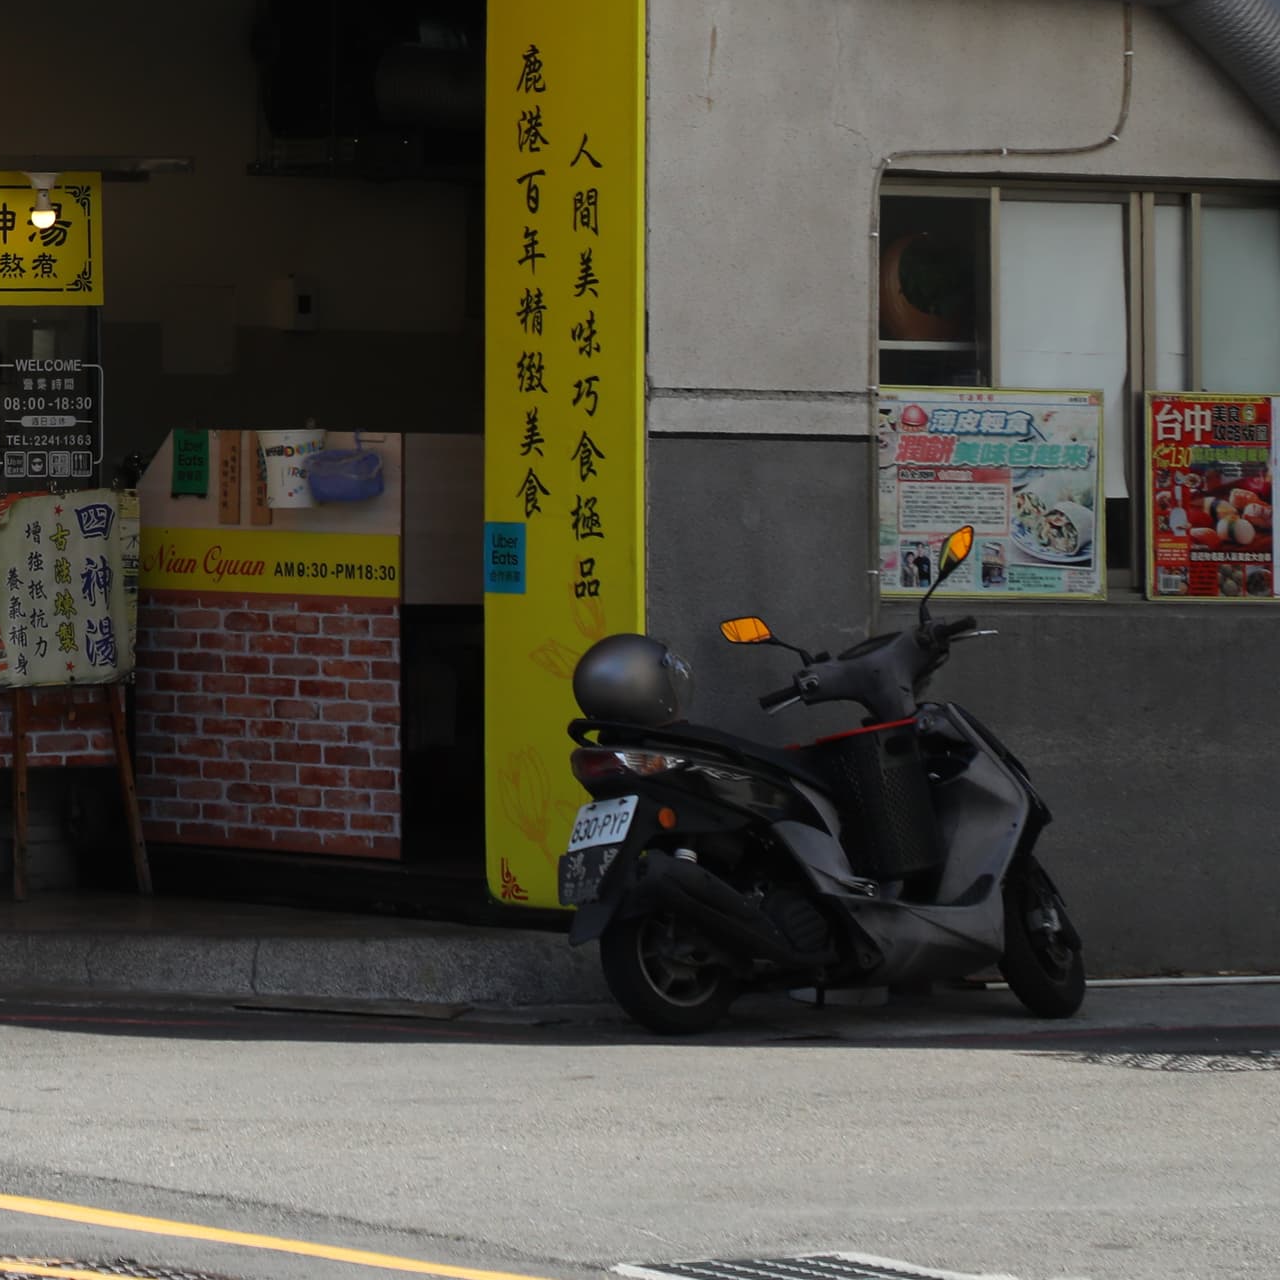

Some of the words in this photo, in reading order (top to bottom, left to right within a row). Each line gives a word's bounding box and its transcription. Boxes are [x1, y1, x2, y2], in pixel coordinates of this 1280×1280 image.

[15, 359, 82, 373] WELCOME
[570, 132, 606, 599] 人間美味巧食極品
[1154, 403, 1212, 442] 台中
[23, 521, 49, 659] 增強抵抗力
[73, 502, 117, 667] 四神湯
[491, 550, 519, 566] Eats
[6, 568, 30, 676] 養氣補身
